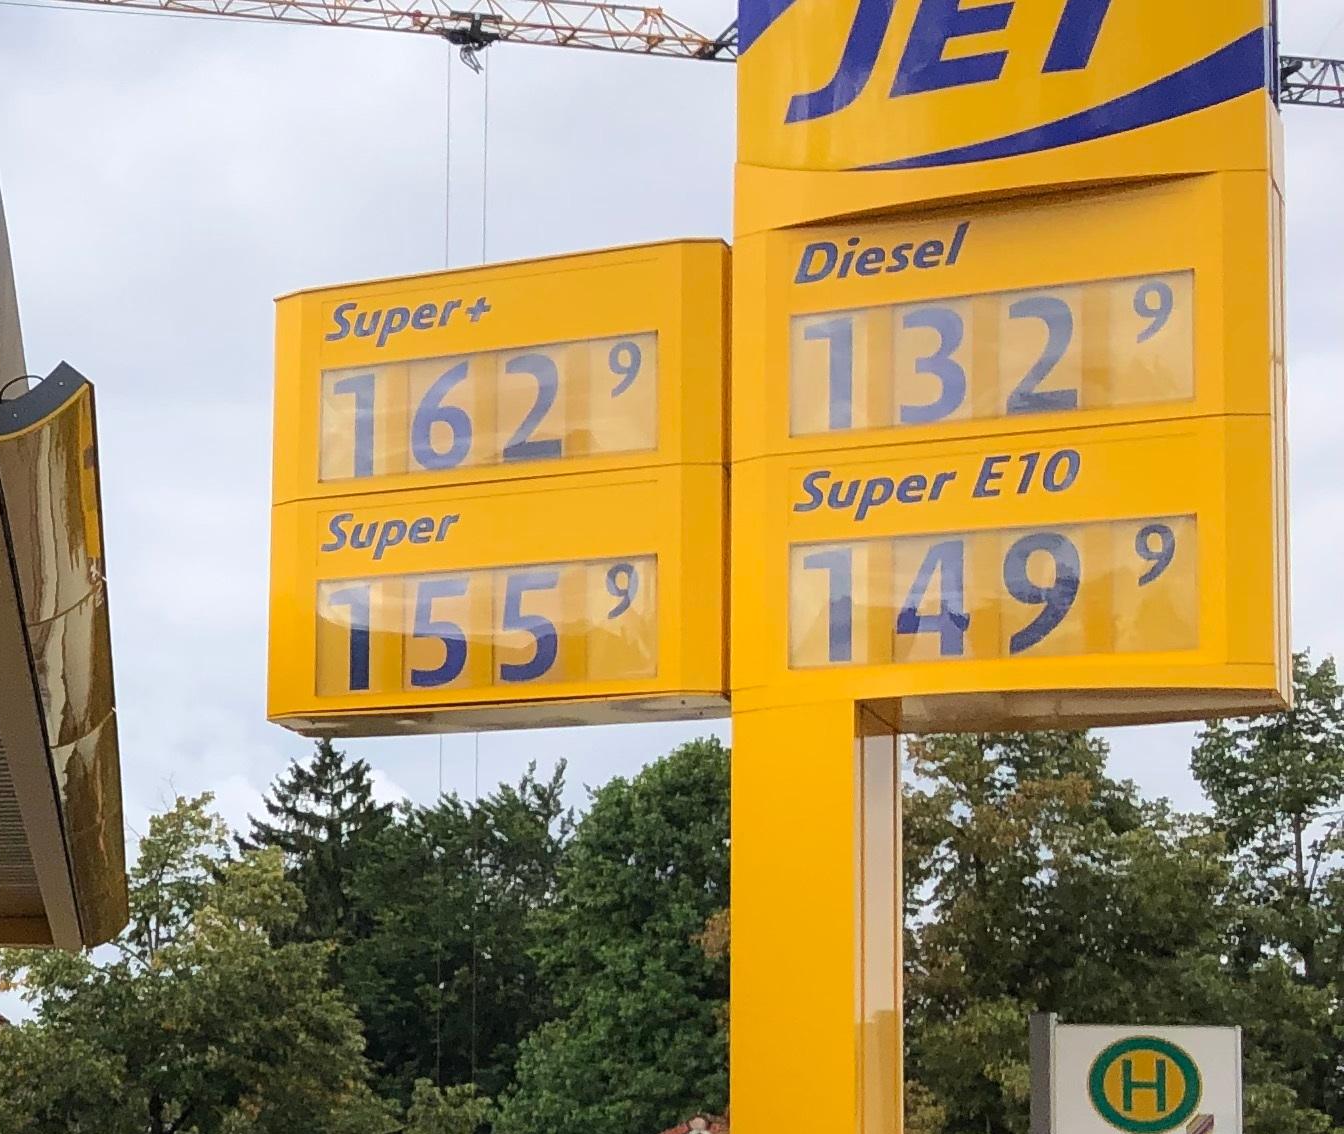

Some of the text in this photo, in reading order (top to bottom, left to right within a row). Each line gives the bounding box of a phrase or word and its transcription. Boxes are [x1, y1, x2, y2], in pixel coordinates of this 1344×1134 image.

[793, 221, 970, 284] Diesel
[325, 296, 492, 348] Super+
[792, 449, 1081, 521] Super E10
[321, 512, 461, 560] Super
[1121, 1058, 1167, 1112] H
